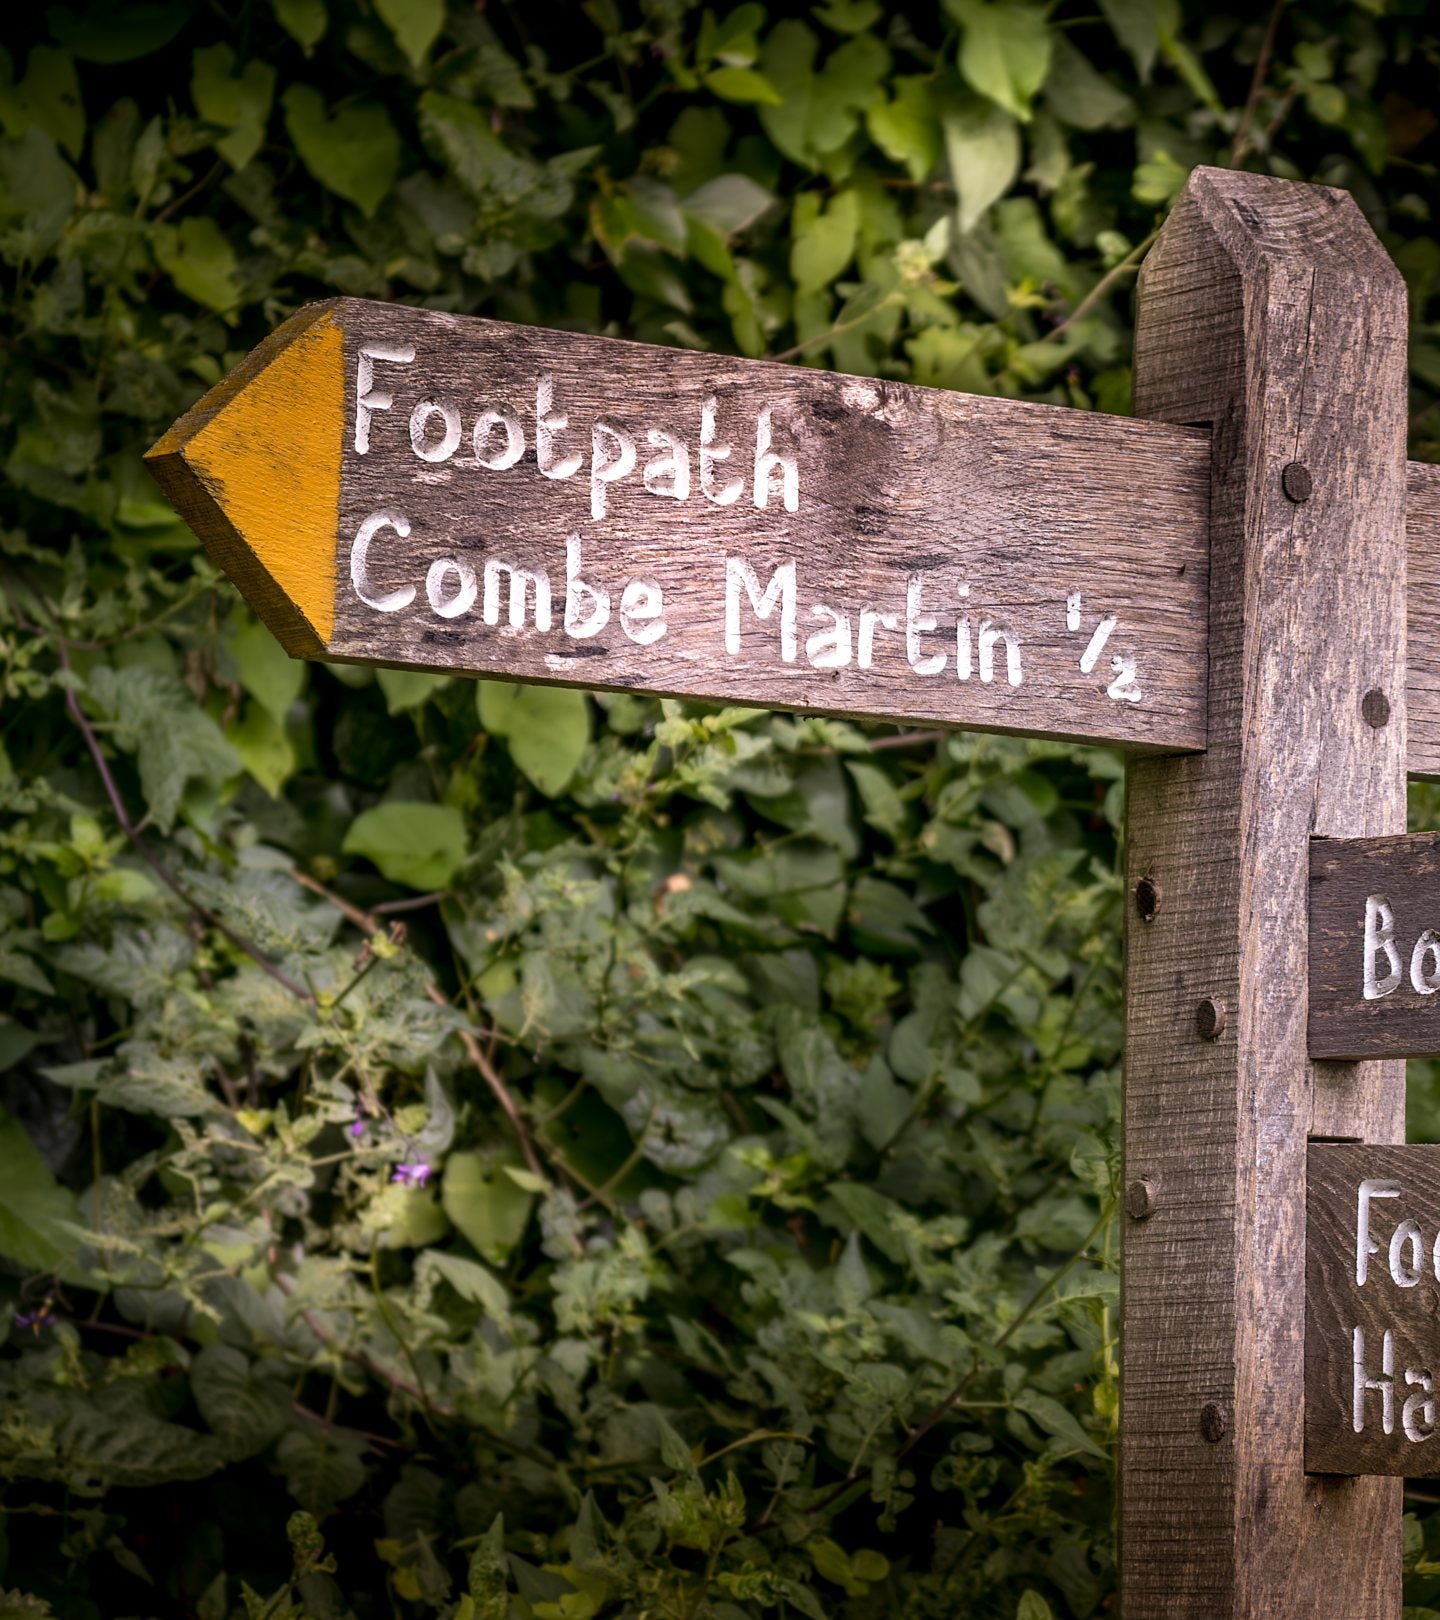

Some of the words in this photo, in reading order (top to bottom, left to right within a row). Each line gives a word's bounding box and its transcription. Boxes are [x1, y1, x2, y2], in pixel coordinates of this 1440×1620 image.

[353, 341, 800, 521] Footpath
[350, 507, 668, 646] Combe
[725, 550, 1023, 688] Martin
